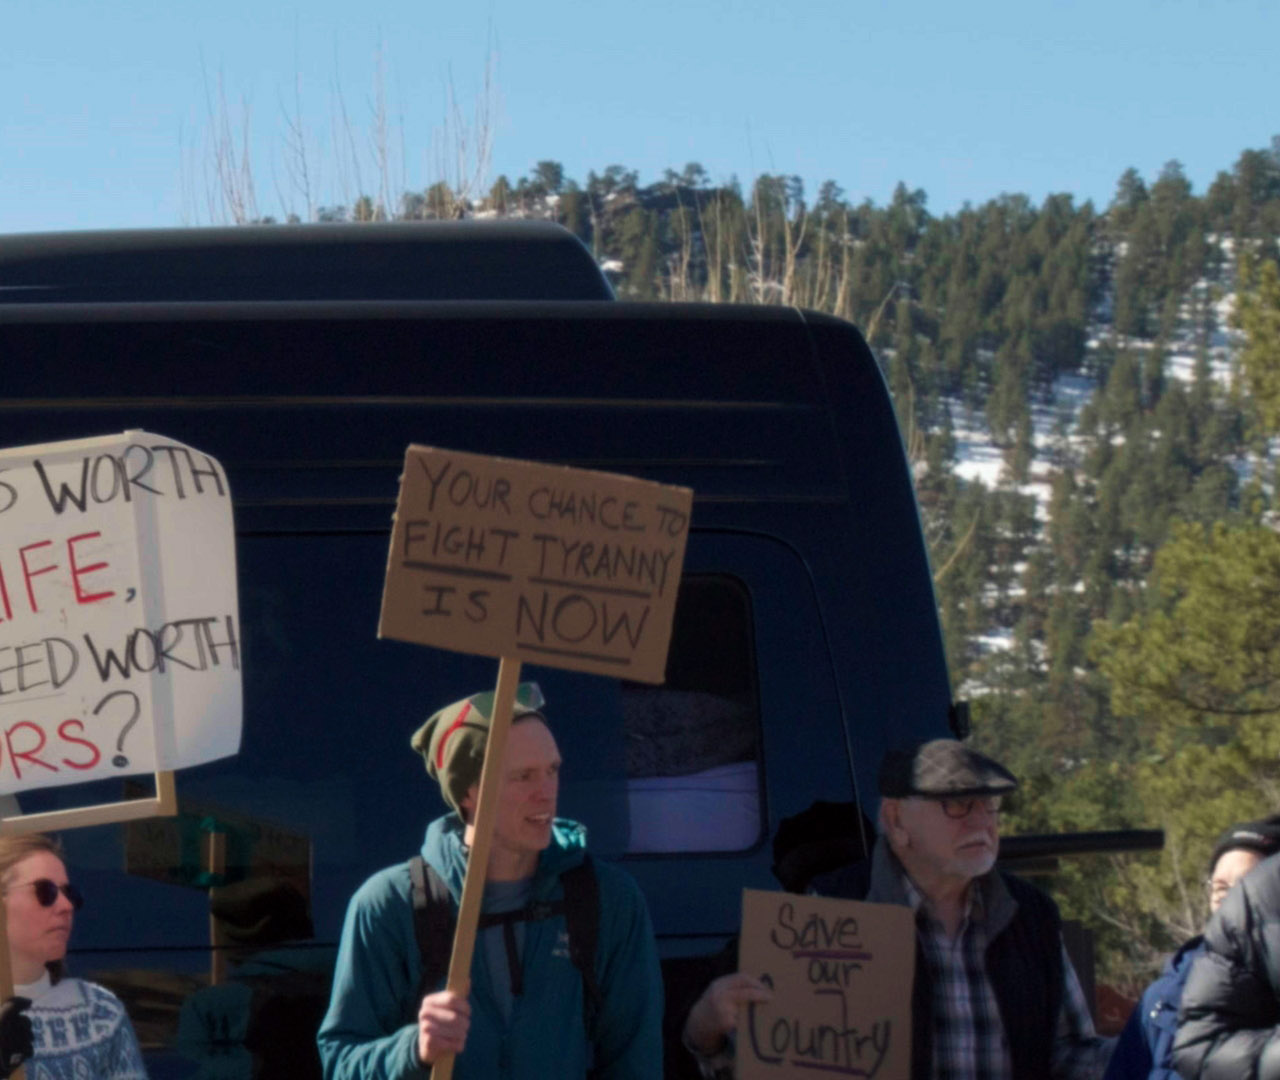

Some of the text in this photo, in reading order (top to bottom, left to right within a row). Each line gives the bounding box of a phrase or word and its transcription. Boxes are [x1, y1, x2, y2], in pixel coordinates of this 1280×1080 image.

[34, 445, 227, 514] WORTH
[418, 456, 688, 538] YOUR CHANCE TO
[403, 520, 675, 598] FIGHT TYRANNY
[84, 615, 241, 682] WORTH
[421, 584, 651, 650] IS NOW
[771, 902, 863, 950] Save
[807, 958, 864, 987] our
